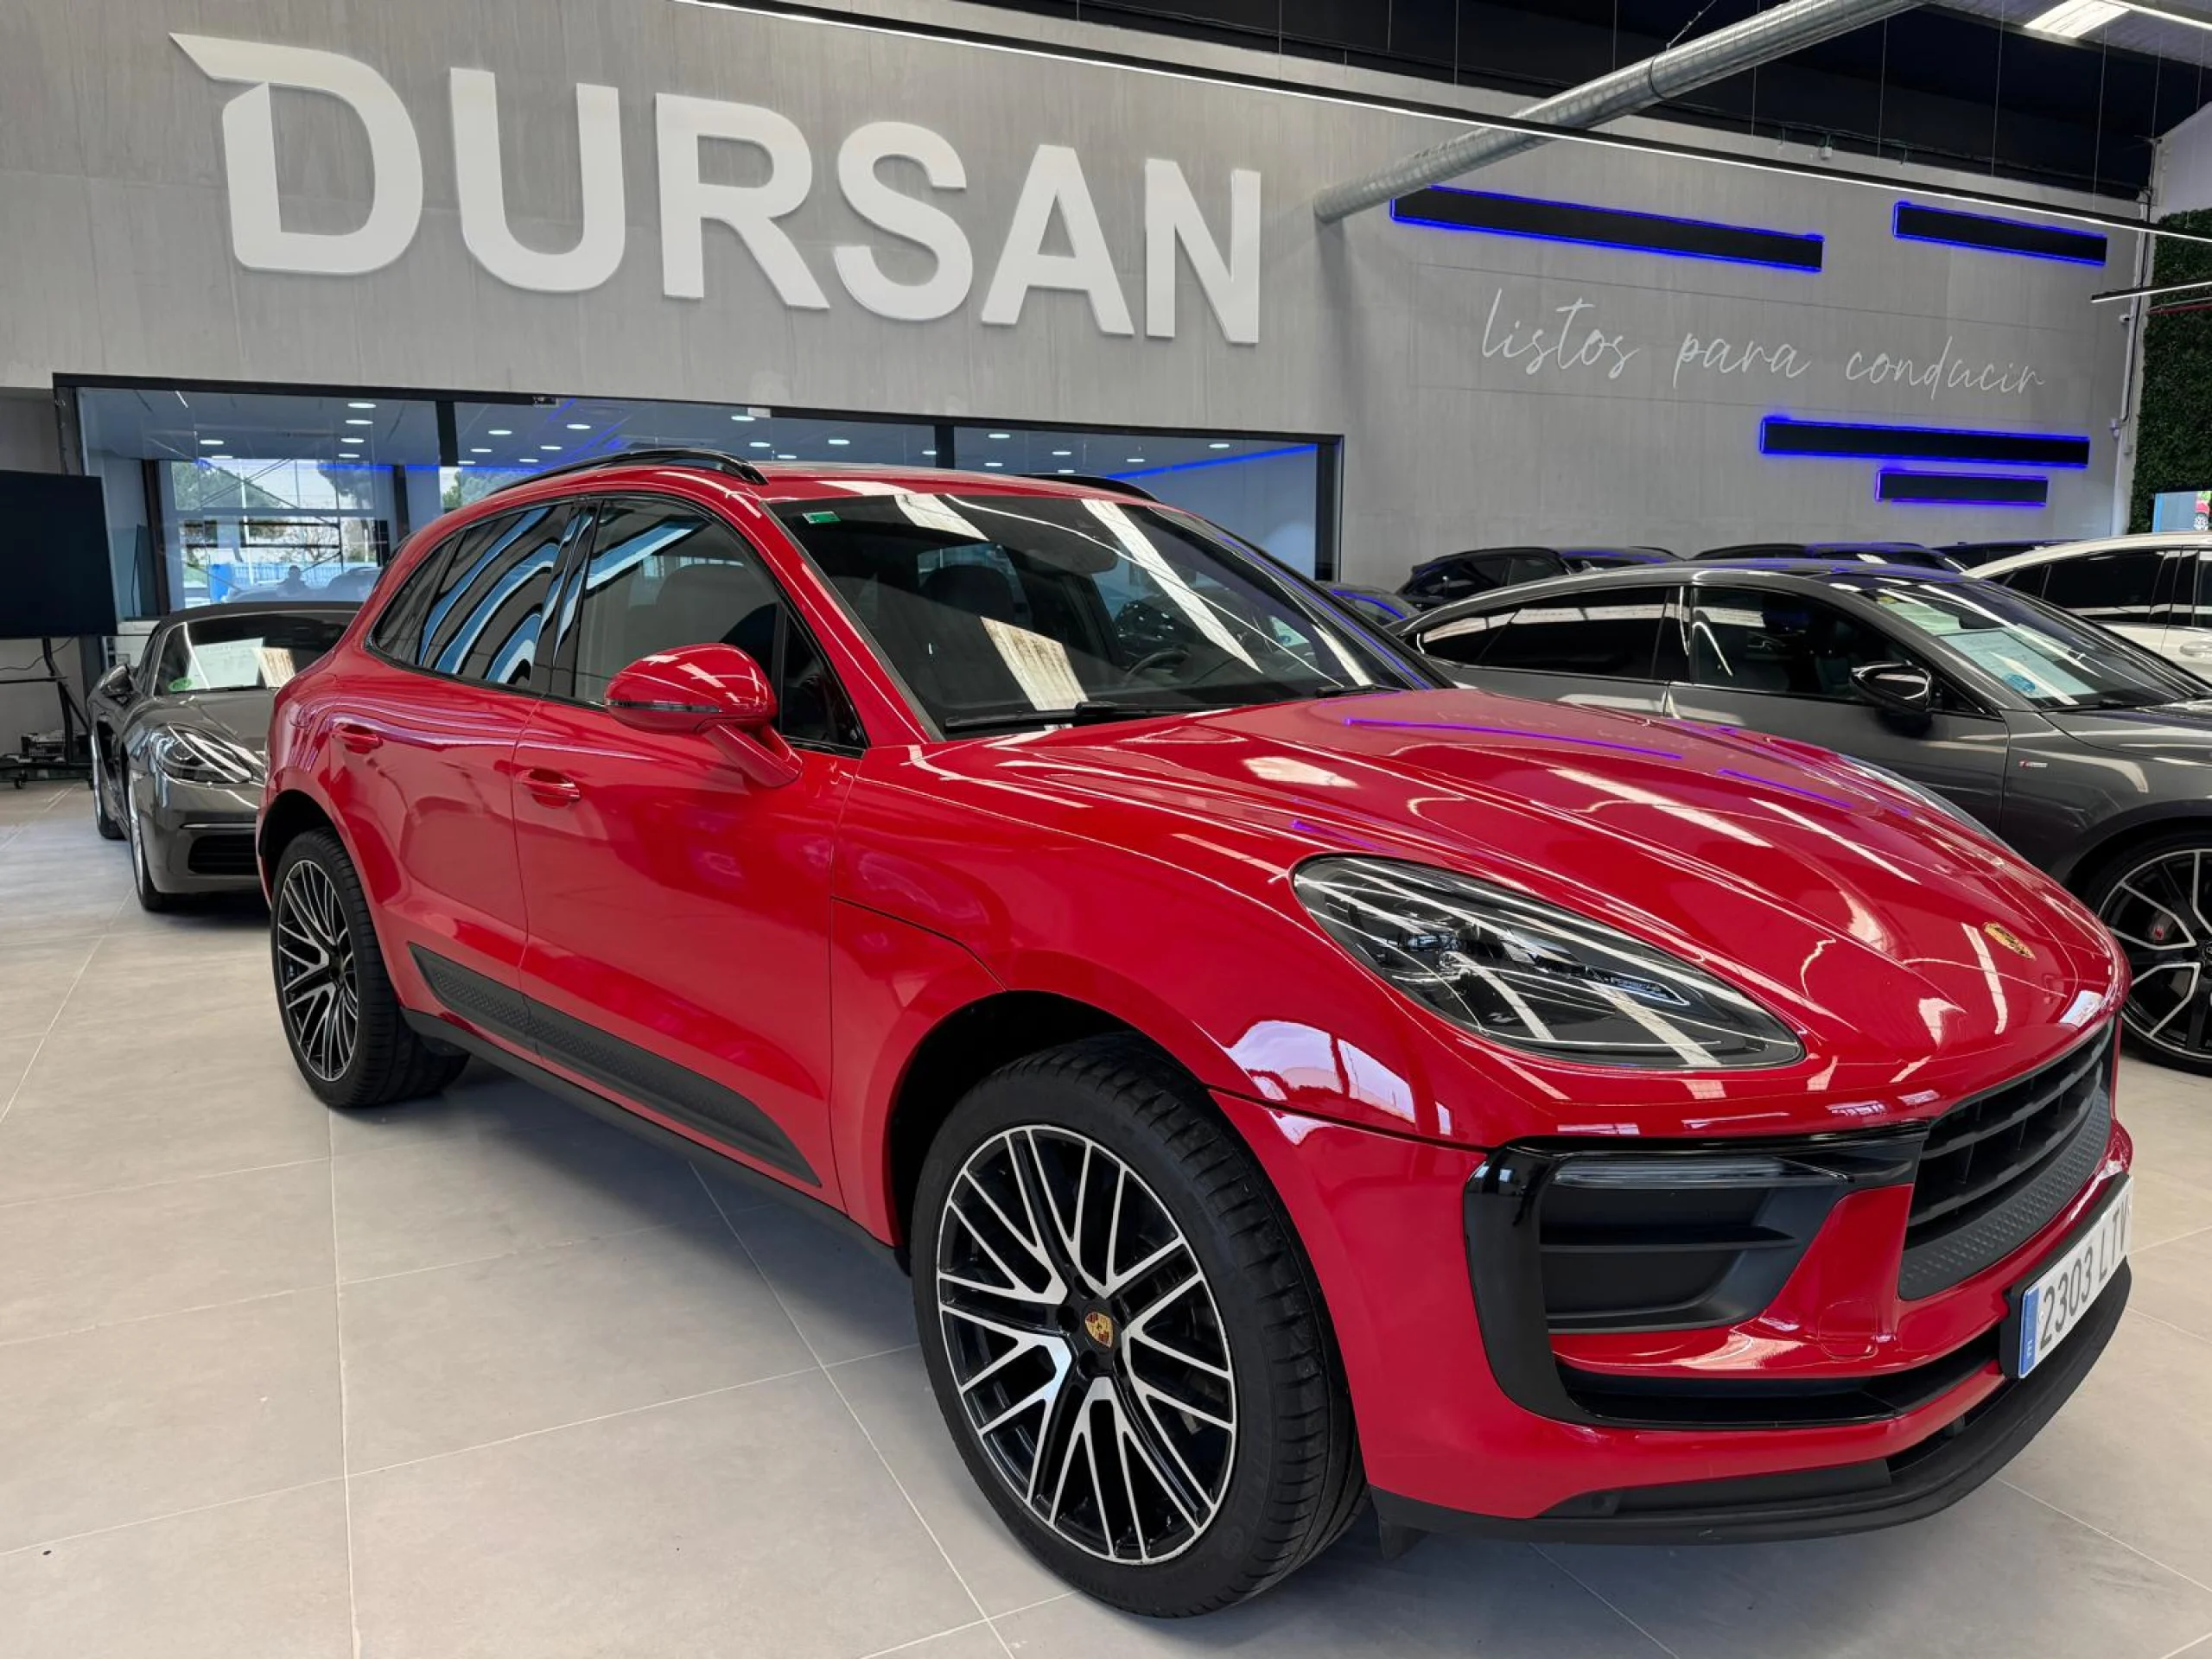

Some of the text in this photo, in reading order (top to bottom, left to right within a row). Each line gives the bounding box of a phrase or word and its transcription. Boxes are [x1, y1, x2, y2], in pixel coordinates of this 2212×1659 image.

[171, 33, 1261, 345] DURSAN
[1482, 288, 2045, 400] listos para conducir
[2039, 1246, 2093, 1351] 2303
